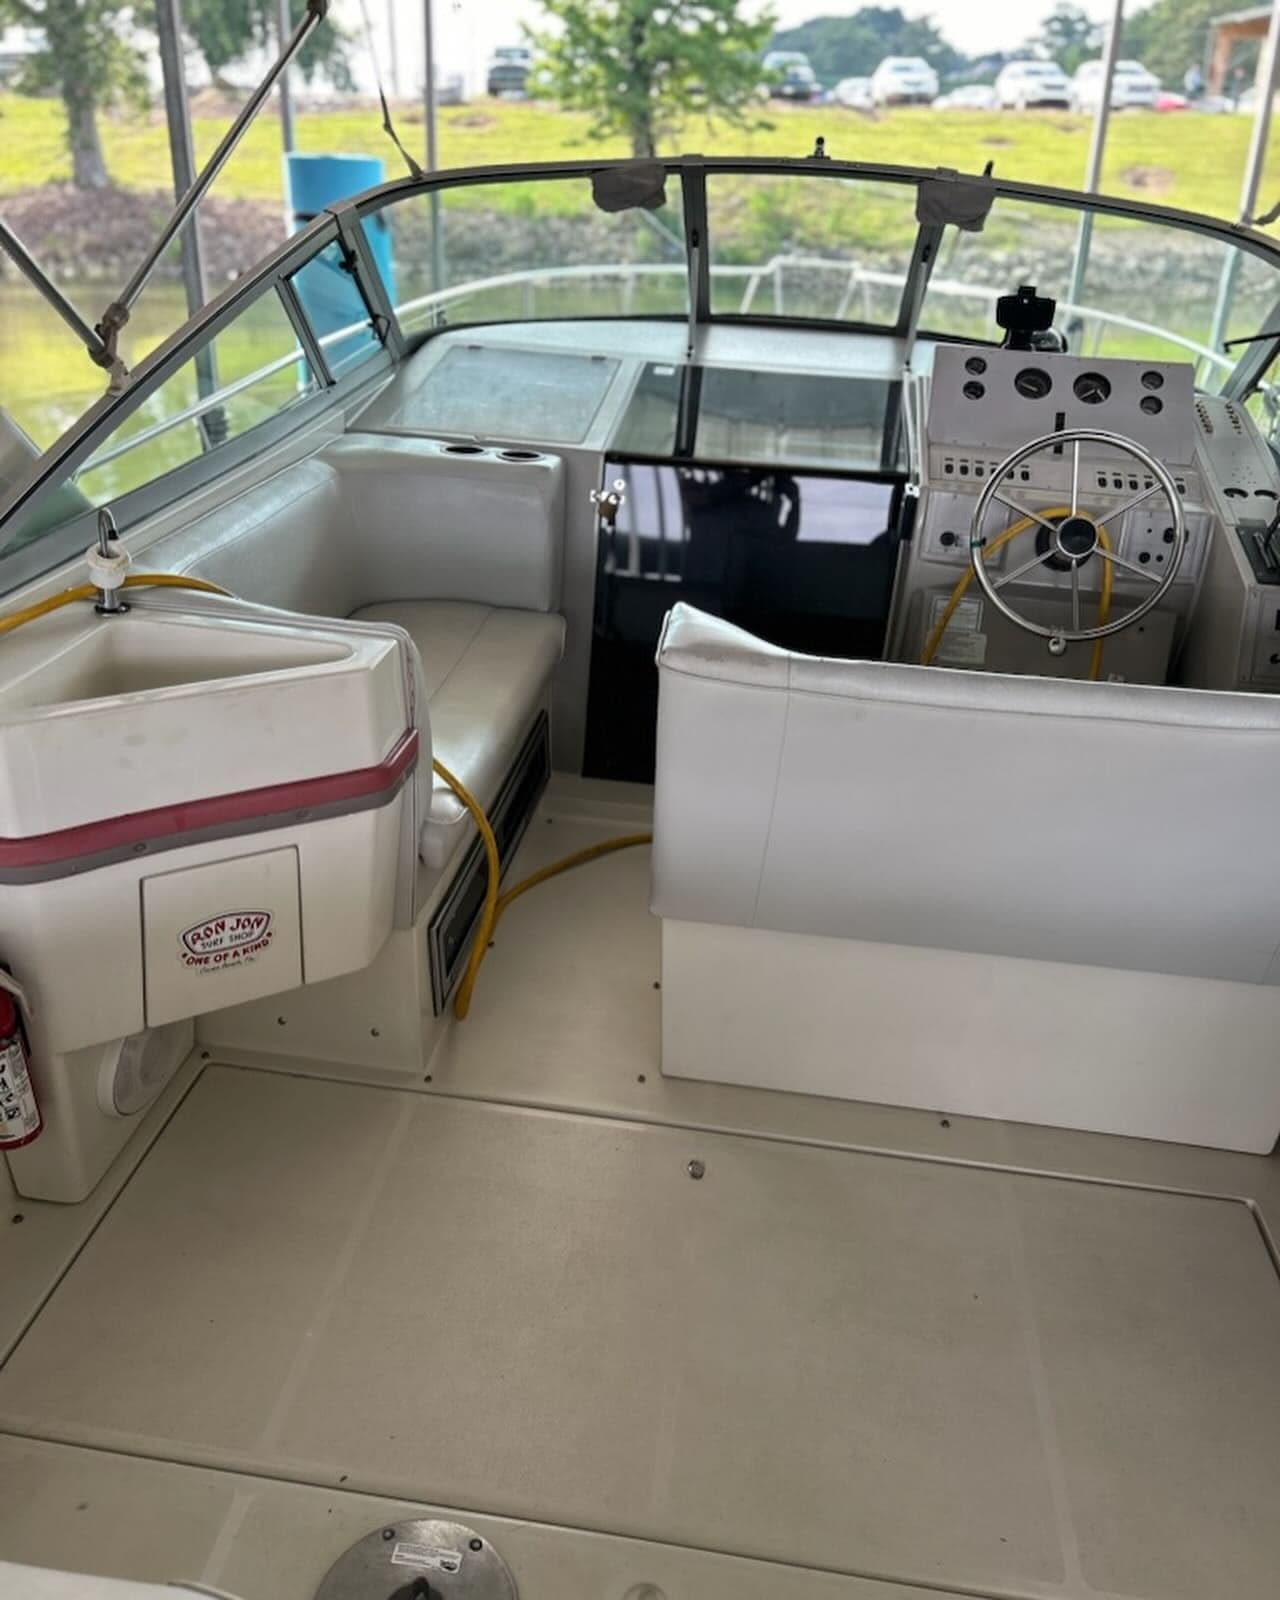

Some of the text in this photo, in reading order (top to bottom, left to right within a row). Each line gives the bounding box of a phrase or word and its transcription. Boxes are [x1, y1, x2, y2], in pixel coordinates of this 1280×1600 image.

[191, 916, 264, 945] RON JON
[201, 931, 254, 949] SURF SHOP
[214, 953, 229, 963] OF
[232, 951, 240, 959] A
